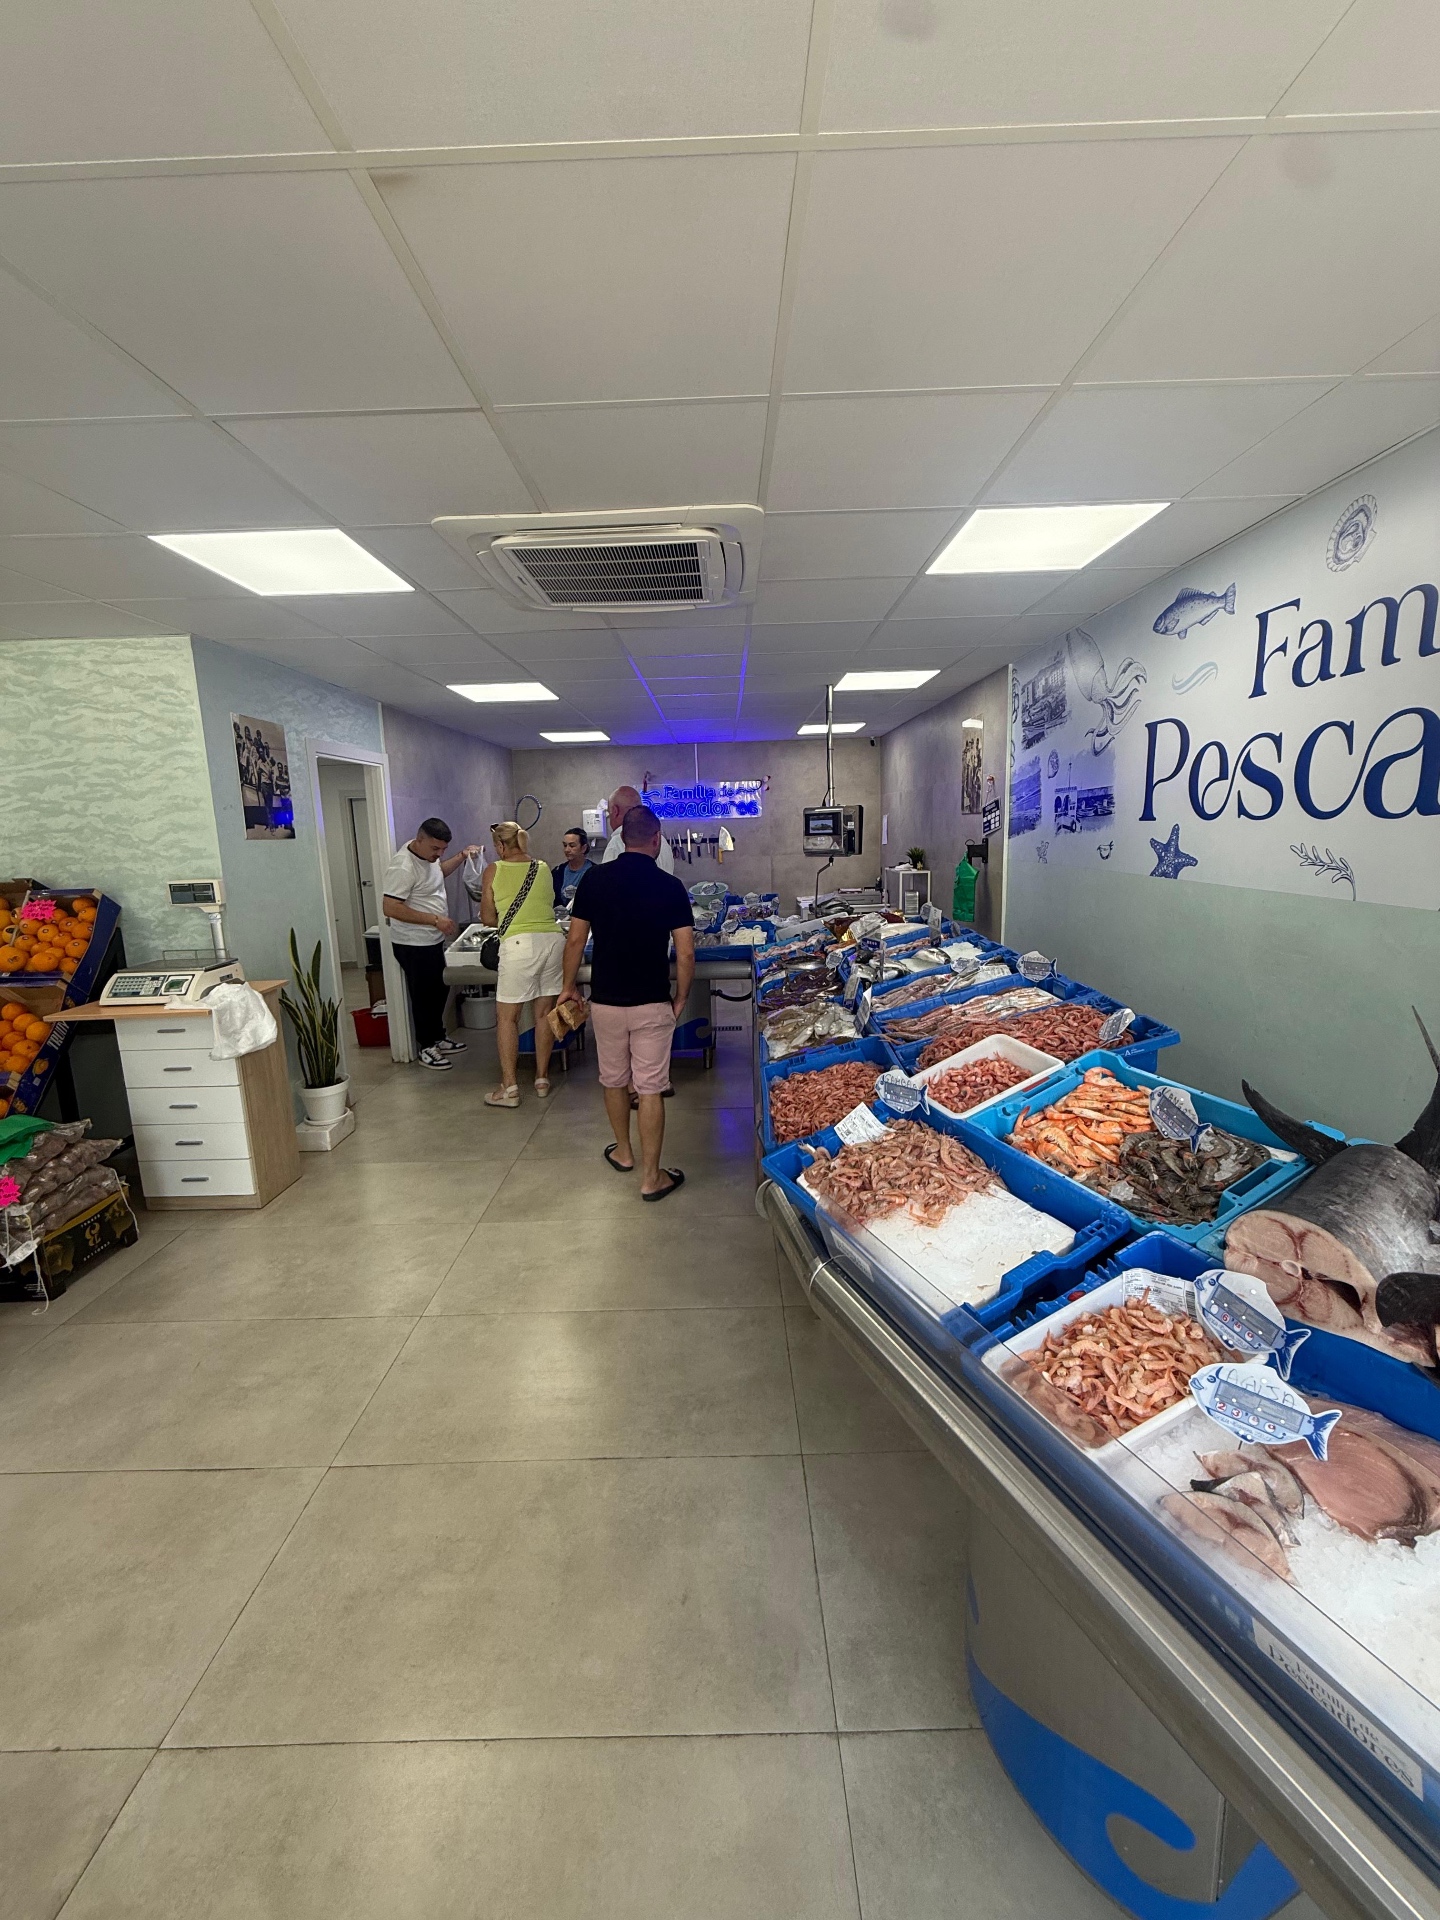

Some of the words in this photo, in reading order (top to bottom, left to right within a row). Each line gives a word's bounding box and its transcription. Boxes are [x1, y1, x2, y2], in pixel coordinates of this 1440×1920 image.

[1248, 583, 1440, 699] Fam
[1138, 707, 1440, 821] Pesca
[1269, 1644, 1415, 1788] Pescadores
